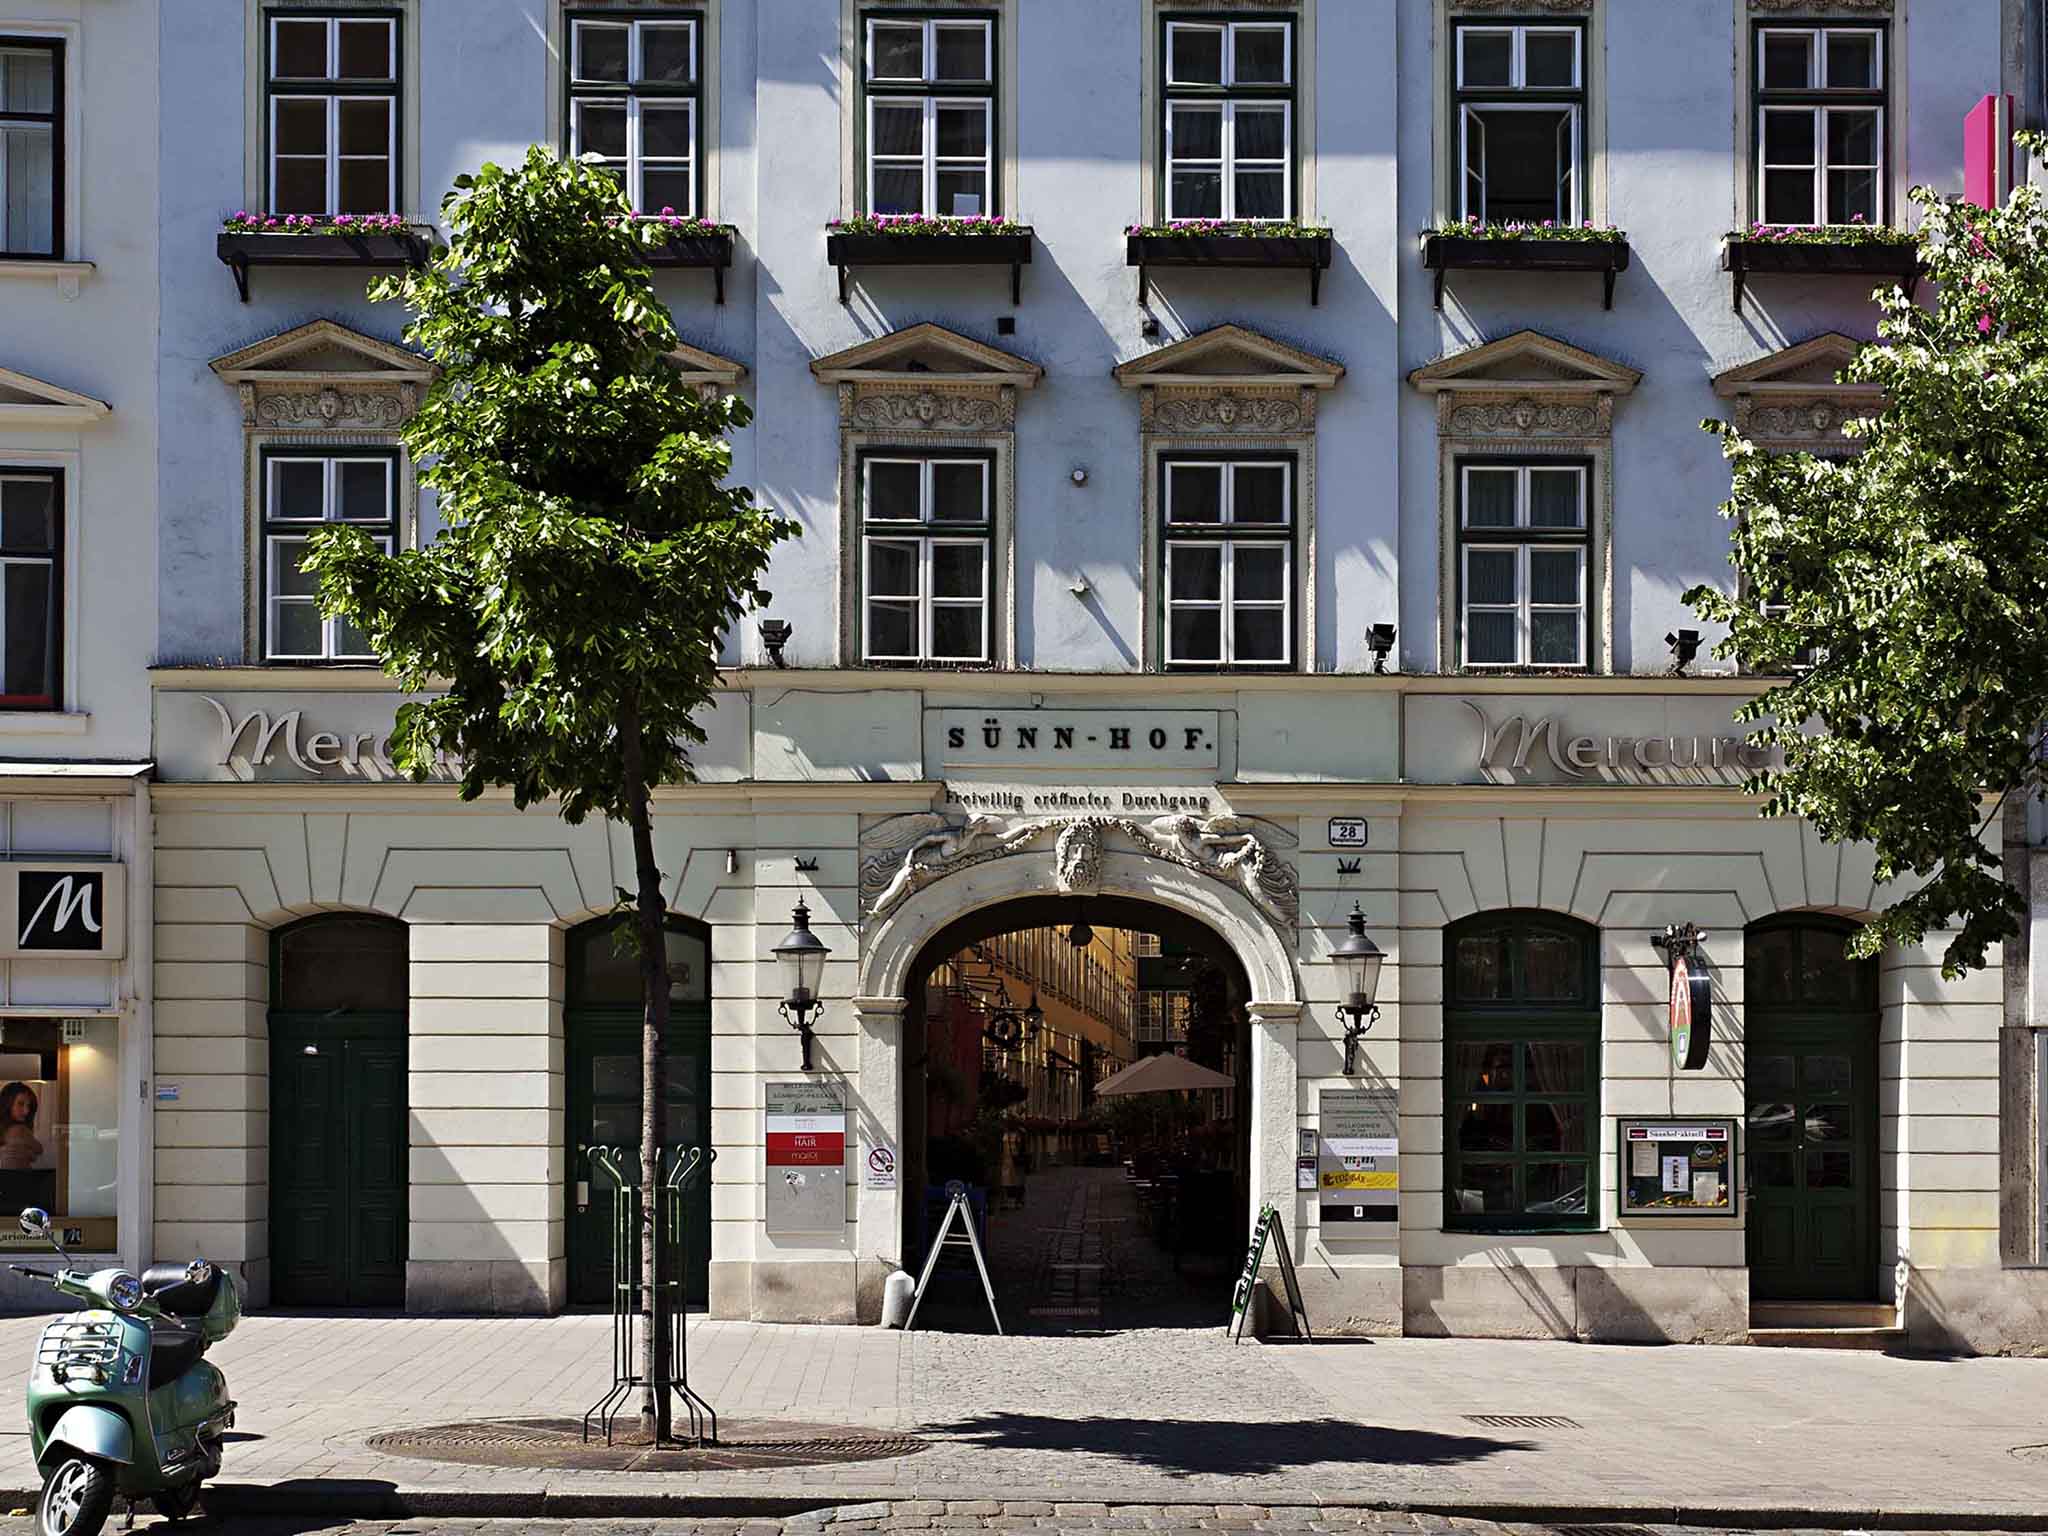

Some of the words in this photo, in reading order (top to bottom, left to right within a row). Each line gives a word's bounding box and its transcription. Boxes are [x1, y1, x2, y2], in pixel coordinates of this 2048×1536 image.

[948, 718, 1213, 750] SÜNN-HOF.
[945, 790, 1024, 810] Freiwillig
[1121, 792, 1211, 811] Durchgang
[1340, 826, 1357, 838] 28
[794, 1137, 817, 1147] HAIR
